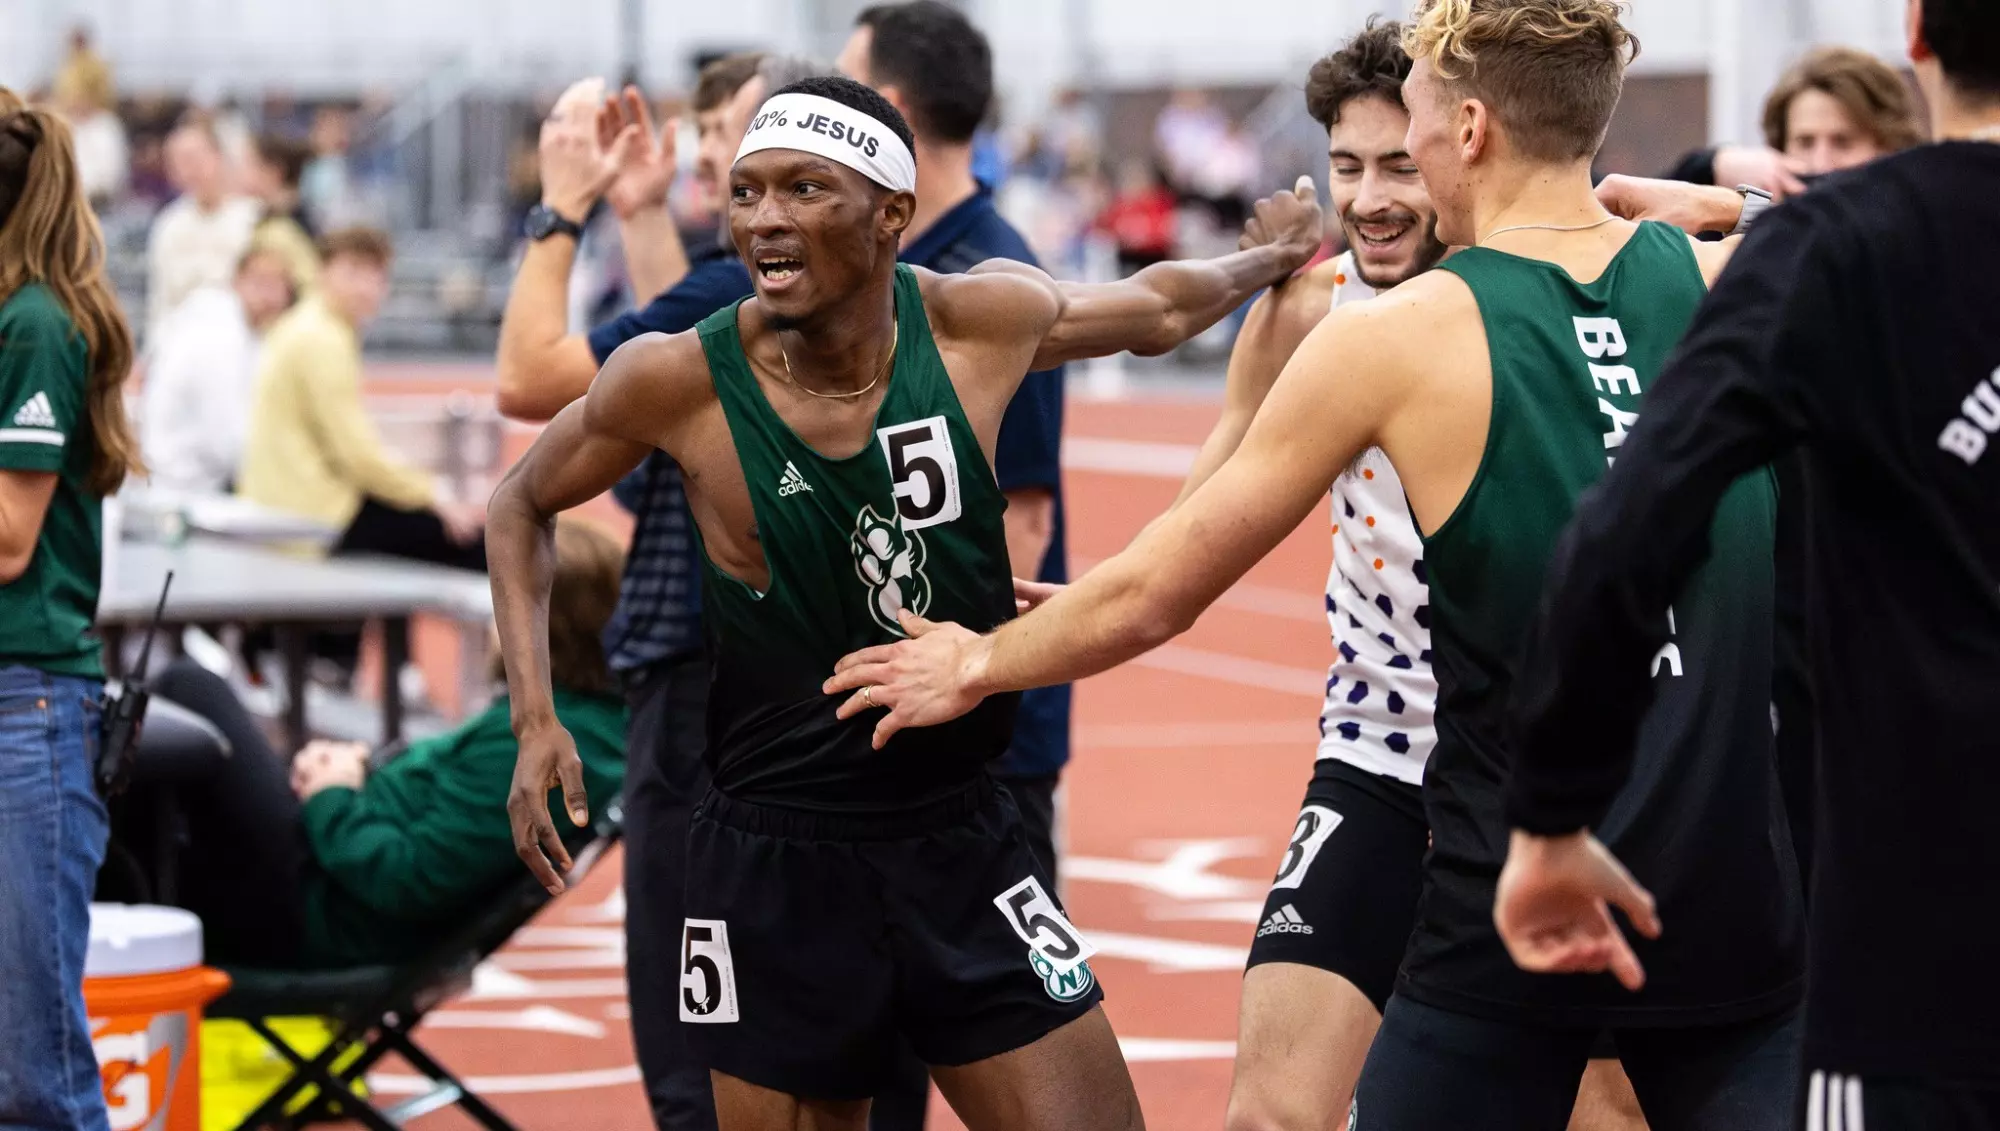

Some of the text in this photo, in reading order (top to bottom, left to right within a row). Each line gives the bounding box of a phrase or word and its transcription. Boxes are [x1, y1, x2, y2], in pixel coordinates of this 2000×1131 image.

[796, 112, 879, 158] JESUS
[887, 426, 946, 521] 5
[1006, 885, 1080, 961] 5
[1256, 923, 1314, 938] adidas
[683, 925, 722, 1016] 5
